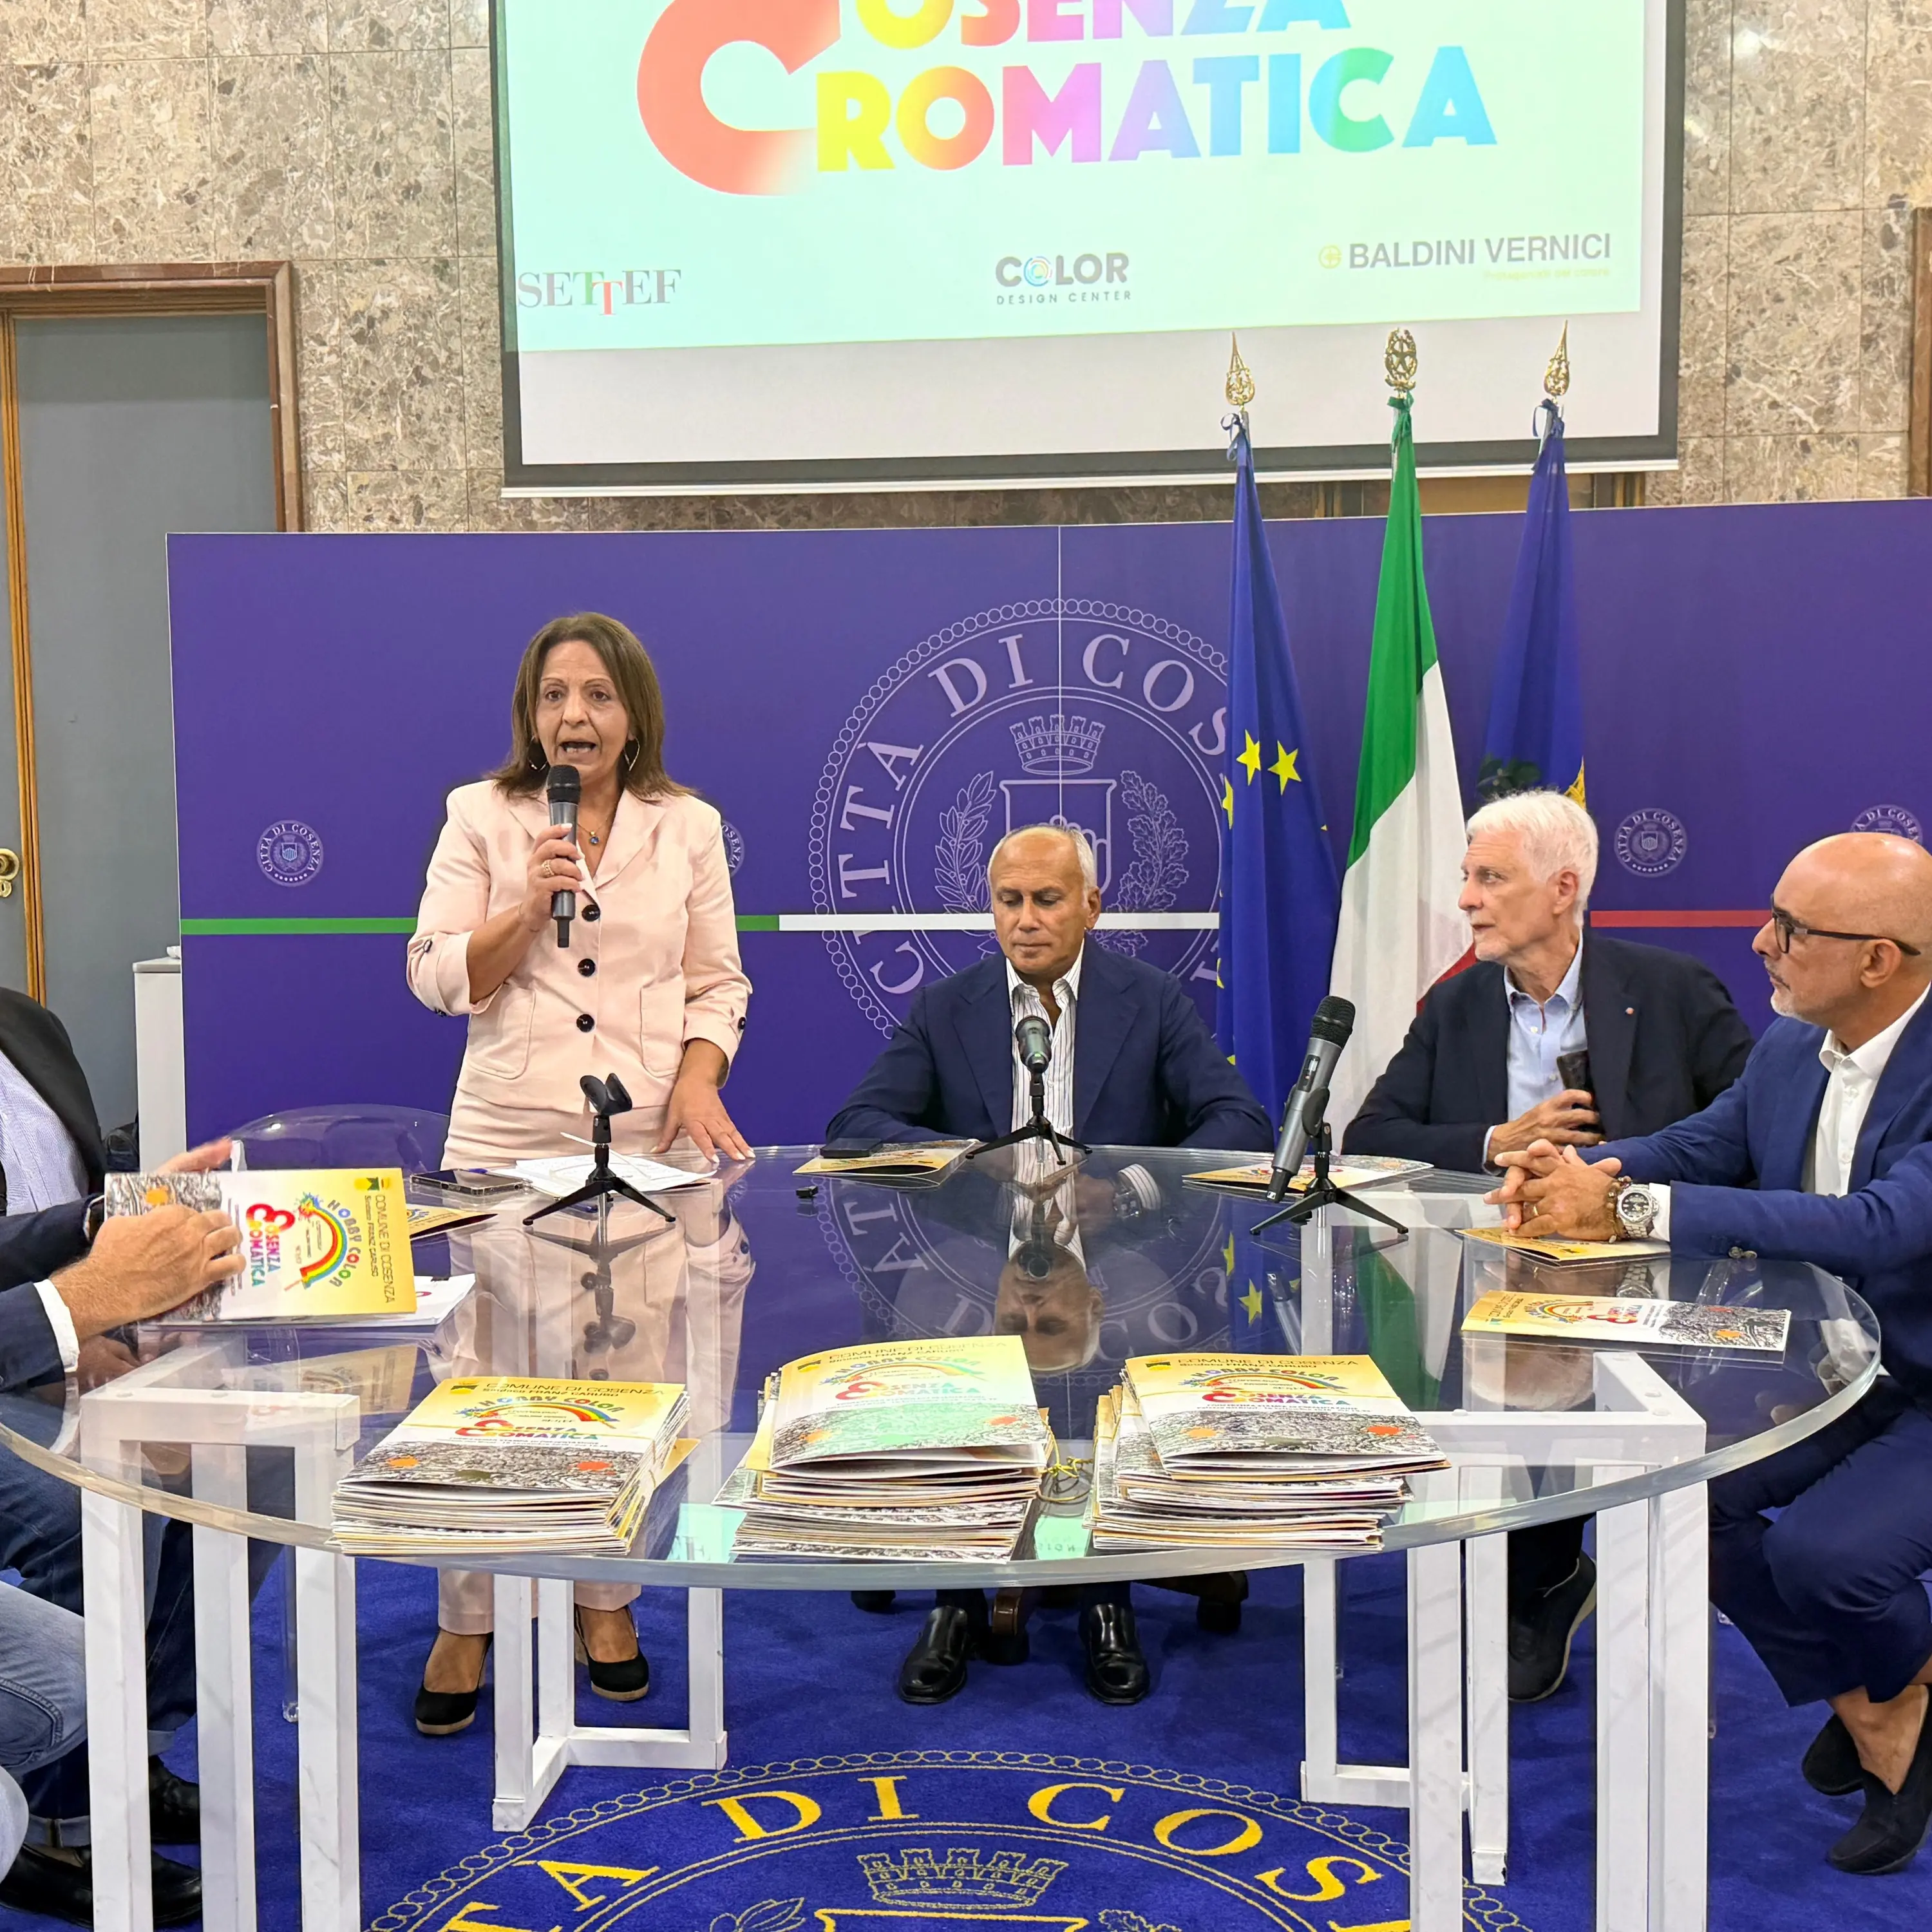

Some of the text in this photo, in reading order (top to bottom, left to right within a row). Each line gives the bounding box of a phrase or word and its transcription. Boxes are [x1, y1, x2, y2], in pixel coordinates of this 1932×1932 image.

[636, 0, 1497, 196] CROMATICA
[996, 252, 1129, 287] COLOR
[1349, 232, 1611, 269] BALDINI VERNICI
[517, 269, 681, 316] SETTEF
[997, 290, 1131, 305] DESIGN CENTER
[928, 634, 1034, 717] DI
[1082, 634, 1228, 755] COS
[272, 824, 286, 836] DI
[292, 824, 321, 871] COSENZA
[721, 824, 741, 868] OSENZA
[1632, 812, 1647, 824] DI
[1653, 812, 1683, 862] COSENZA
[1888, 808, 1919, 840] COSE
[381, 1255, 395, 1303] COSENZA
[701, 1776, 920, 1844] DI
